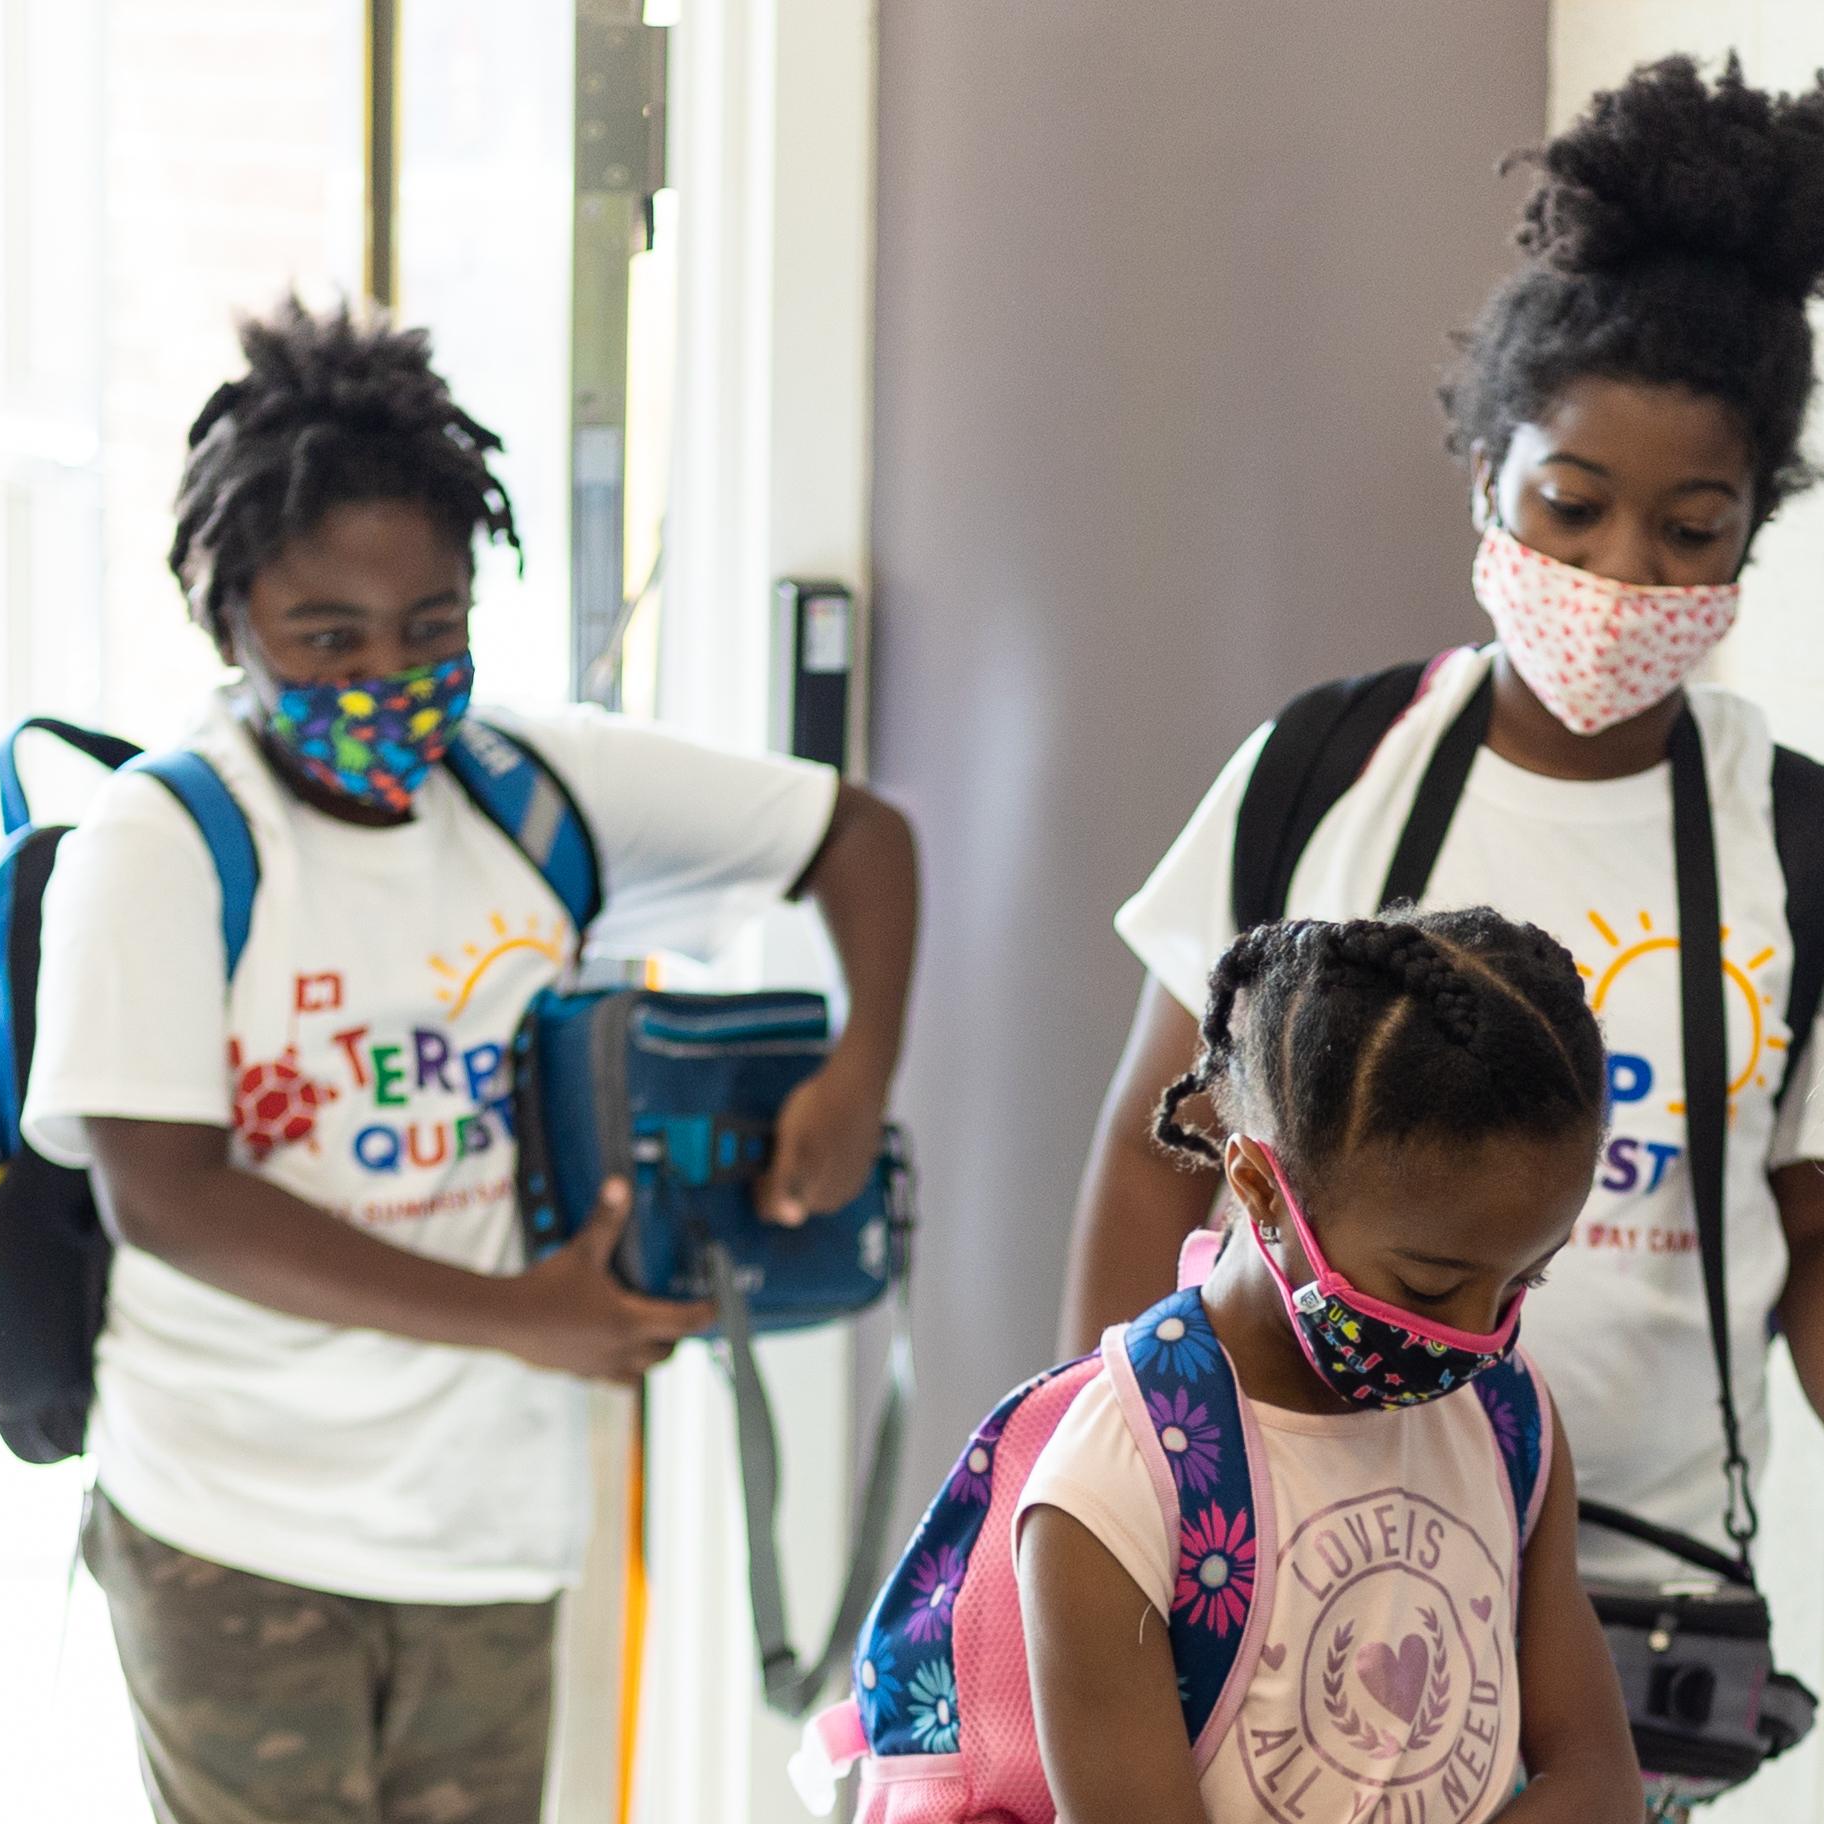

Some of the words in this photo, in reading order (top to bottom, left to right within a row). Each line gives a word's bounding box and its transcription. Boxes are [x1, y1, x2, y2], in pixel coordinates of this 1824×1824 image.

[332, 1026, 506, 1106] TERP
[1250, 1726, 1323, 1821] ALL
[1440, 1678, 1500, 1817] NEED
